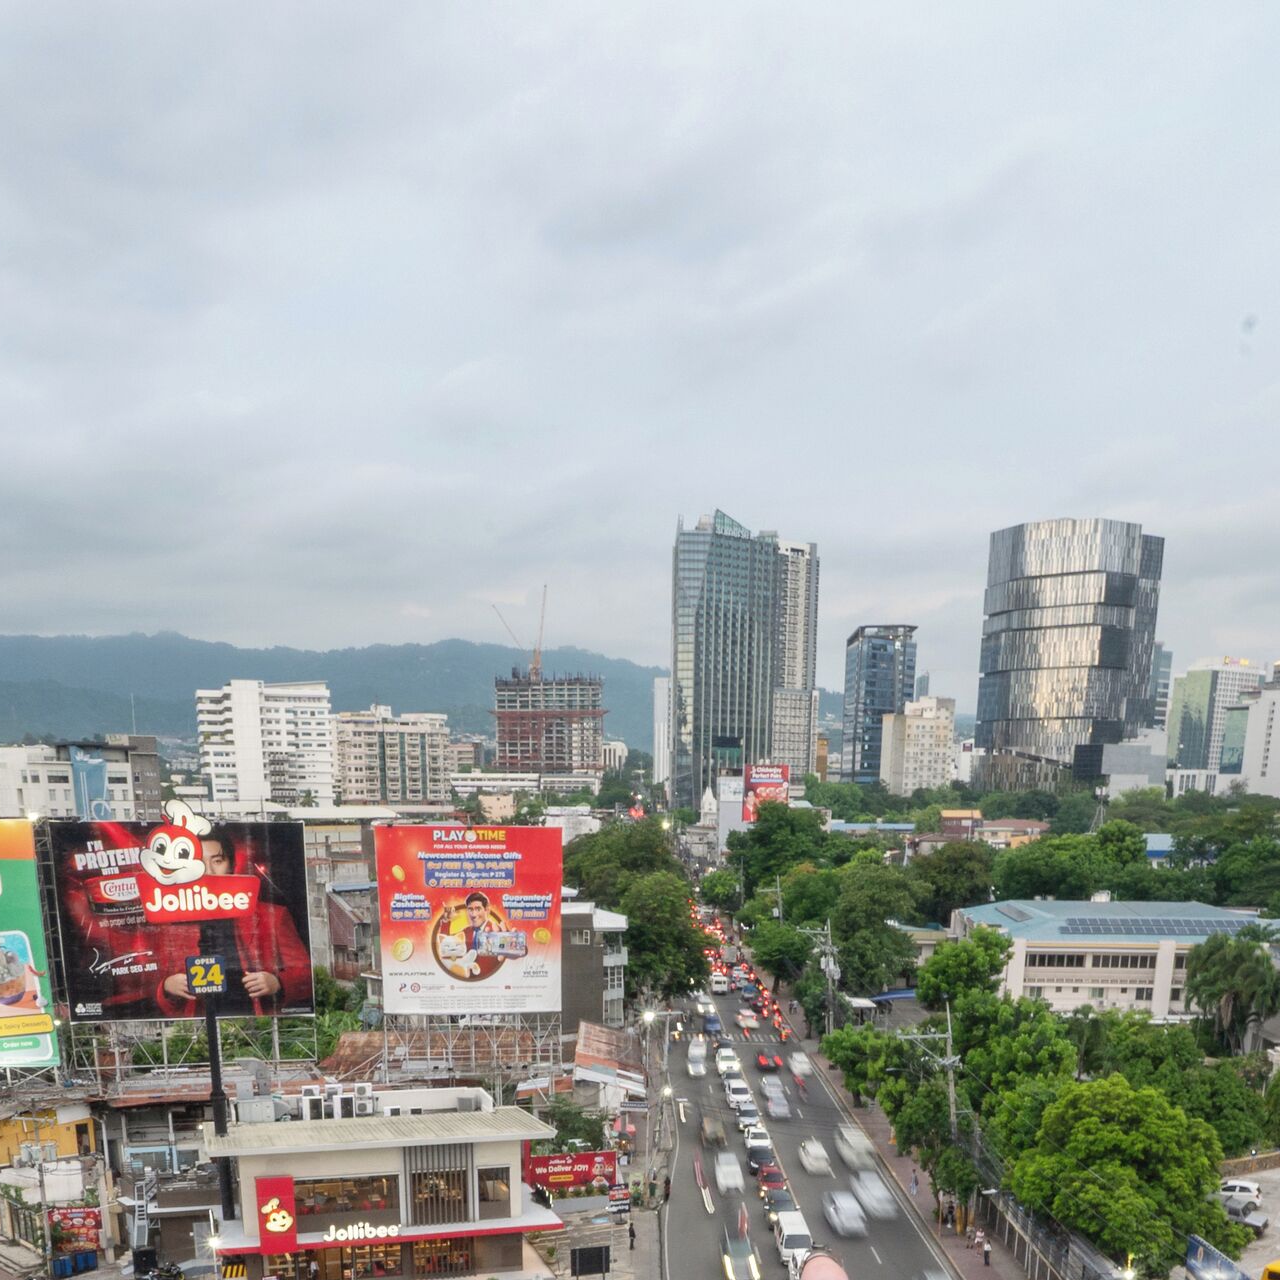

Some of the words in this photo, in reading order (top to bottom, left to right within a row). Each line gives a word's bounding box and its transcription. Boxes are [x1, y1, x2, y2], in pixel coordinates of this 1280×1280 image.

[433, 830, 464, 841] PLAY
[477, 830, 506, 840] TIME
[86, 840, 104, 852] I'M
[418, 852, 464, 860] Newcomers
[101, 866, 120, 876] WITH
[146, 885, 250, 912] Jollibee
[112, 967, 128, 976] PARK
[130, 965, 143, 974] SEO
[190, 964, 224, 987] 24
[194, 985, 223, 994] HOURS
[548, 1165, 572, 1173] Deliver
[323, 1221, 400, 1243] Jollibee
